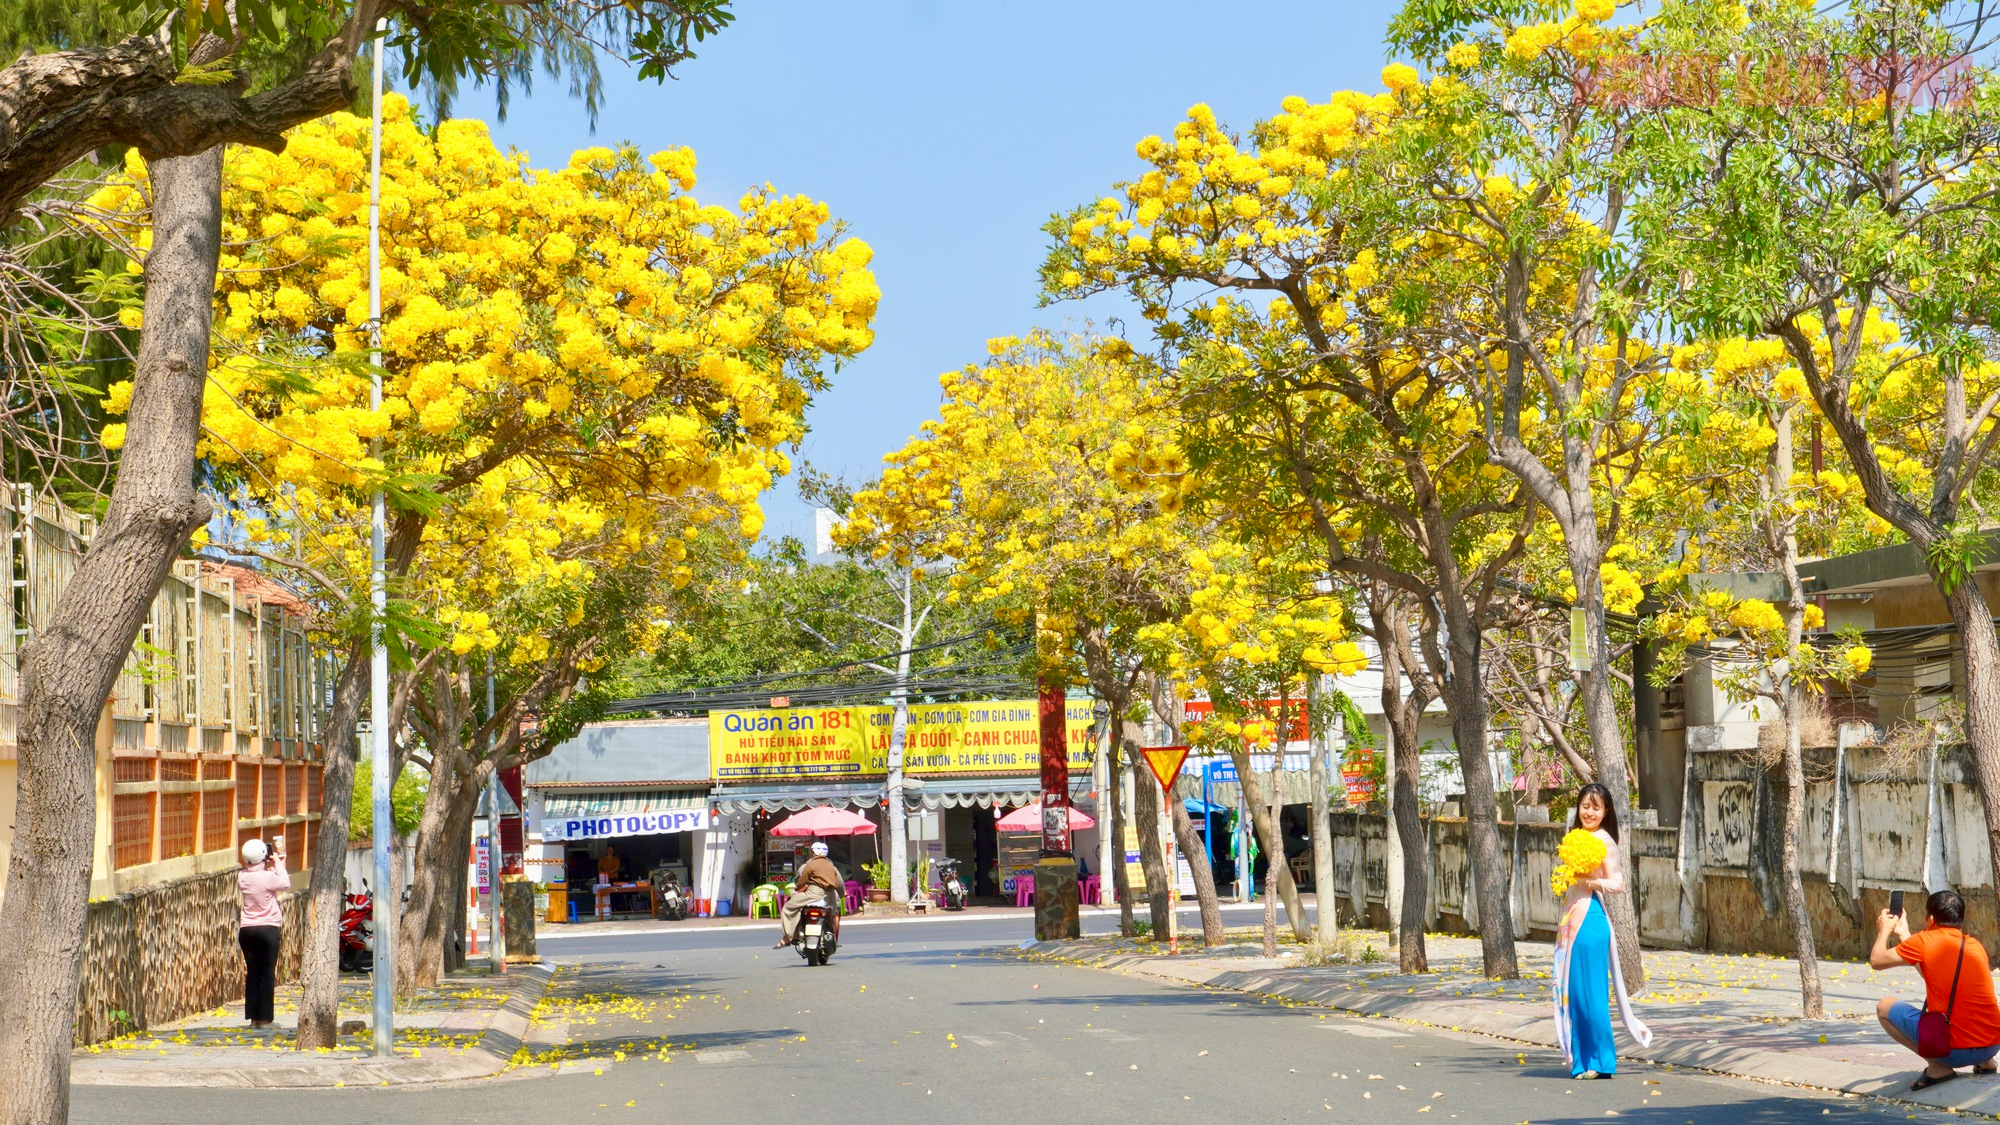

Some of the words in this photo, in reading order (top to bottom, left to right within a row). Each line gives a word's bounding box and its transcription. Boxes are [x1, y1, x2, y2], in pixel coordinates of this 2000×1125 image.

[724, 713, 783, 732] Quán
[788, 712, 814, 731] ăn
[819, 711, 850, 729] 181
[870, 712, 890, 726] CƠM
[925, 711, 944, 724] CƠM
[970, 709, 989, 723] CƠM
[992, 709, 1006, 722] GIA
[1009, 707, 1030, 722] ĐÌNH
[920, 727, 952, 748] ĐUỐI
[964, 730, 1000, 746] CANH
[1003, 729, 1038, 746] CHUA
[725, 751, 759, 764] BÁNH
[761, 751, 792, 765] KHỌT
[824, 748, 851, 763] MỰC
[926, 752, 950, 767] VƯỜN
[958, 752, 971, 766] CÀ
[973, 751, 990, 765] PHÊ
[1222, 770, 1233, 781] THỊ
[566, 811, 702, 838] PHOTOCOPY
